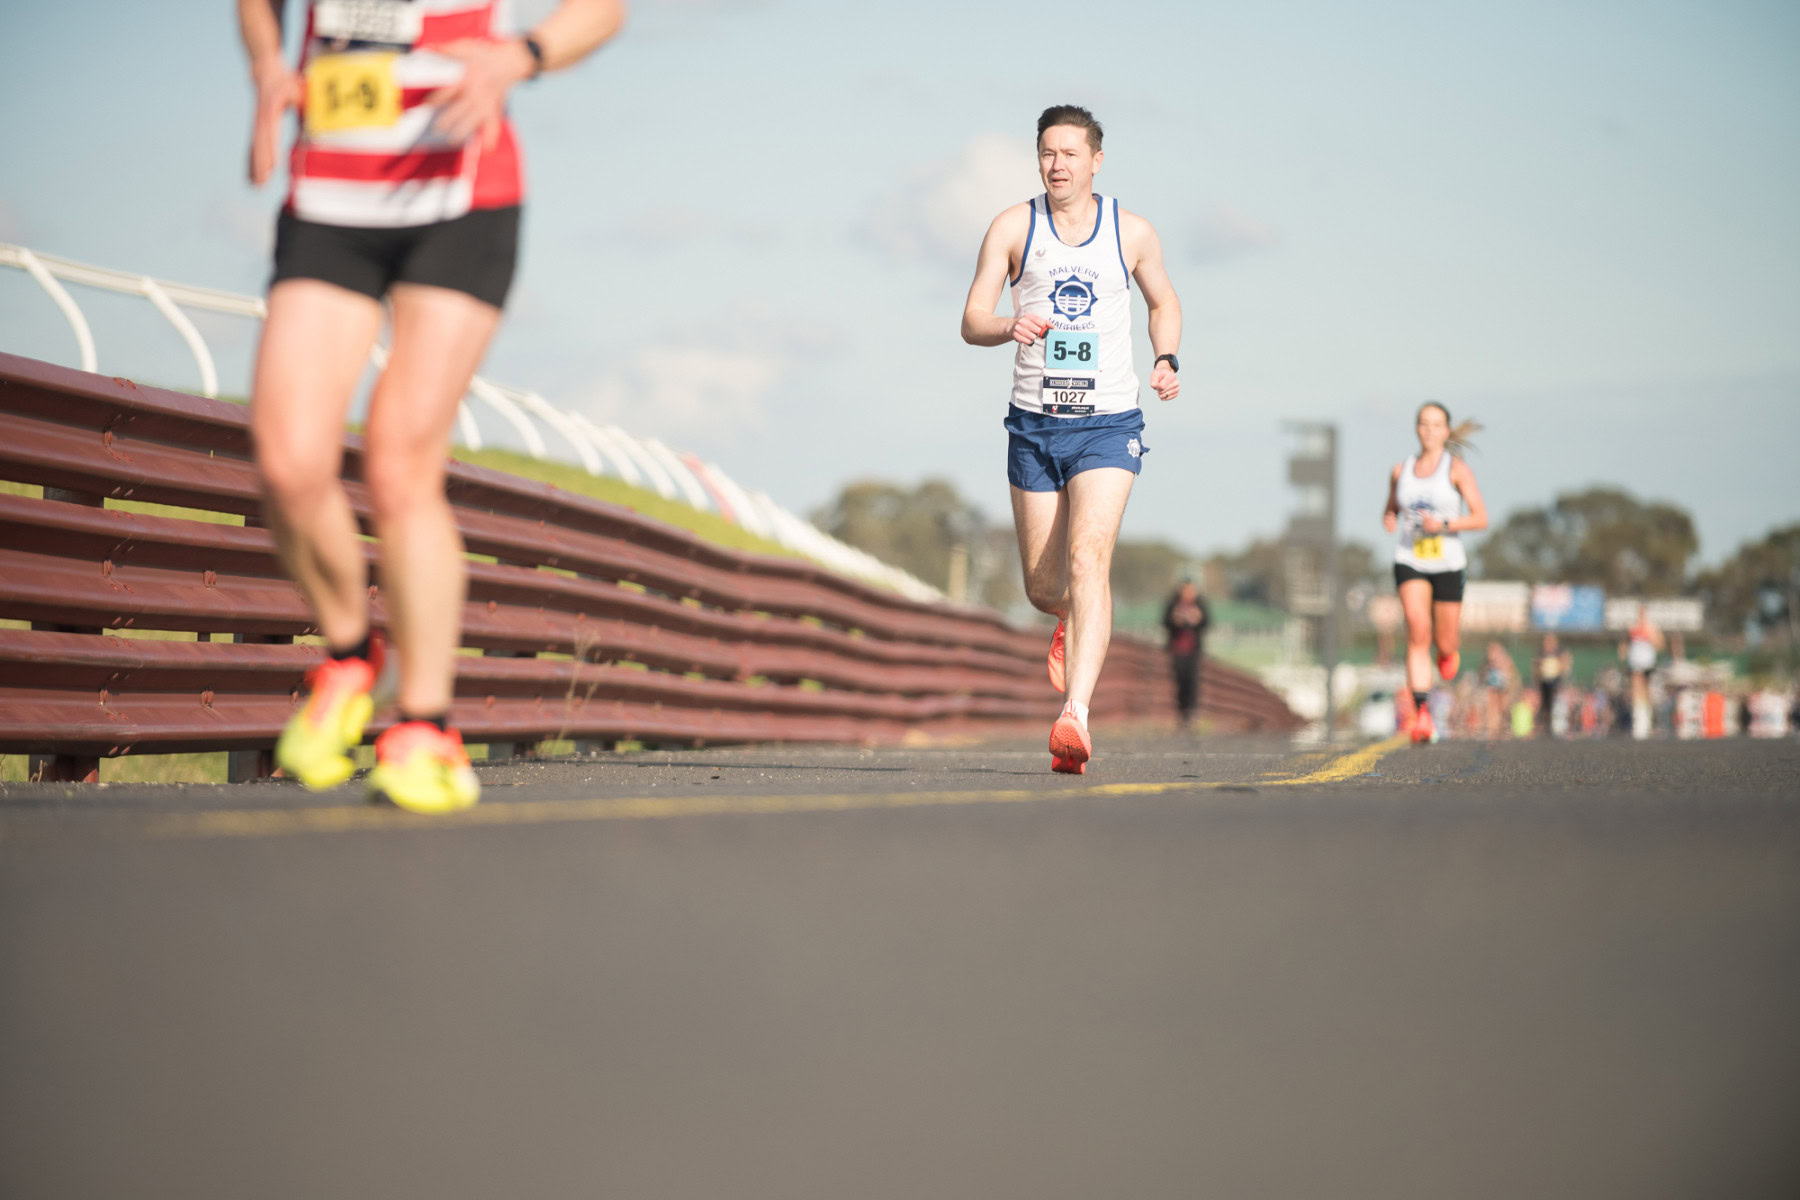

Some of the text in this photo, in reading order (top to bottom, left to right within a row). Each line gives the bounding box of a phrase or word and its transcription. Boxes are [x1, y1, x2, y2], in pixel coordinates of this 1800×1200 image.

[1048, 266, 1100, 280] MALVERN
[1053, 341, 1092, 361] 5-8
[1052, 391, 1087, 404] 1027
